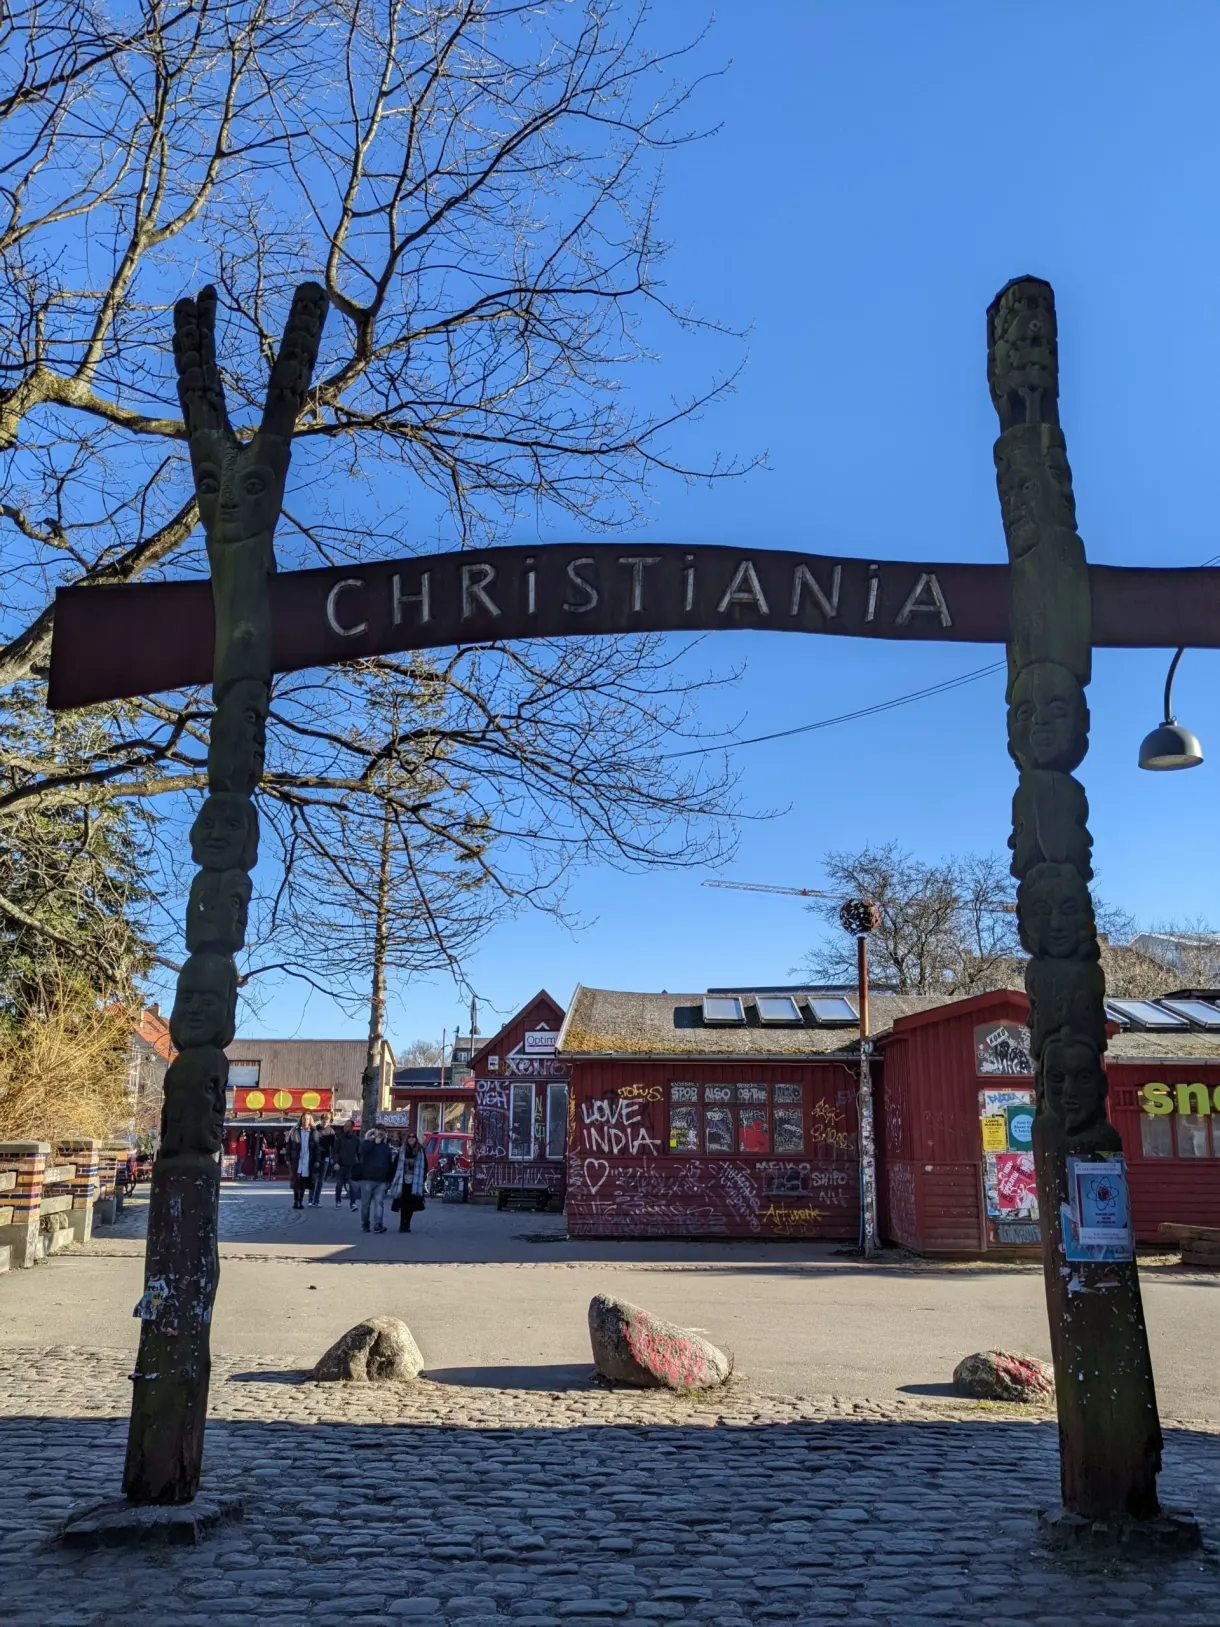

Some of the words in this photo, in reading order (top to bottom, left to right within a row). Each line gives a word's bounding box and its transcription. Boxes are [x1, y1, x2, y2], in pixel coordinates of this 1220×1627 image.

[582, 1098, 643, 1125] LOVE
[1142, 1082, 1220, 1115] sn
[583, 1126, 662, 1156] INDIA
